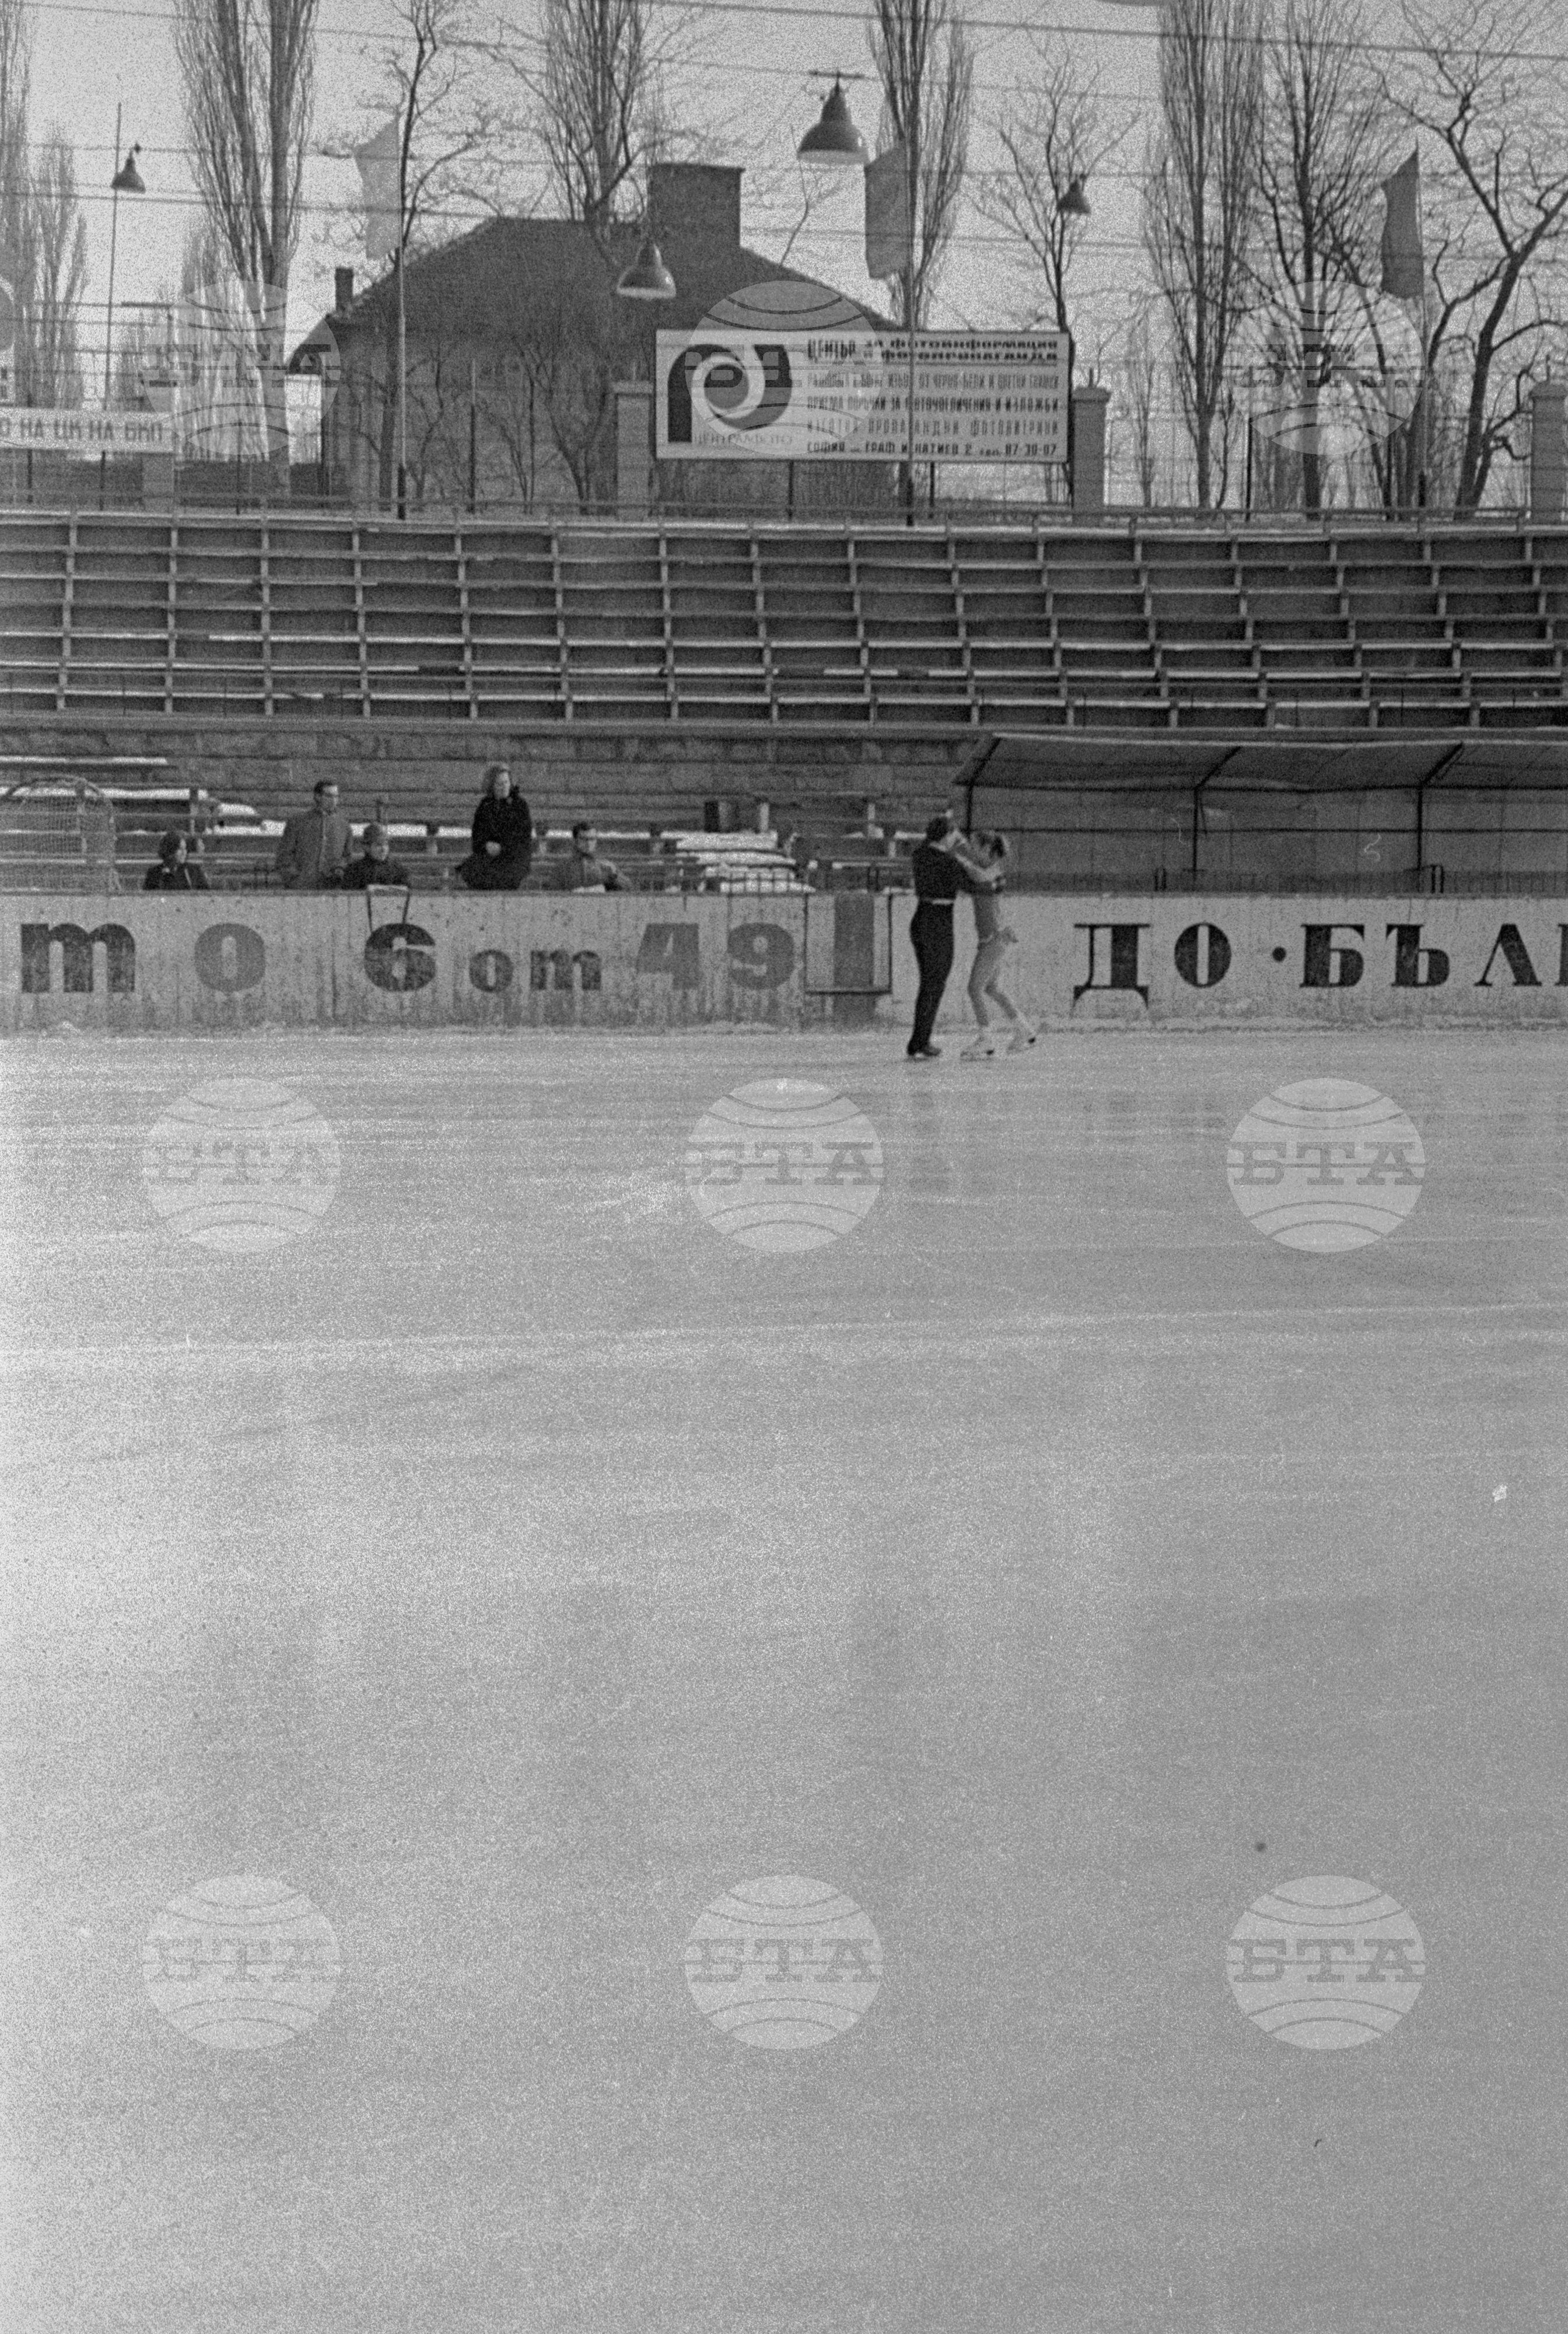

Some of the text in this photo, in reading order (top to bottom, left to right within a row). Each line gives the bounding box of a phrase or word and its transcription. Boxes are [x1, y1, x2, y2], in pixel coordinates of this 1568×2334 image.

[807, 338, 855, 364] ЦЕНТЪР
[881, 349, 1058, 363] фоопропаганда
[869, 418, 960, 436] ПРОПААНДНИ
[901, 442, 959, 456] ИНАТИЕВ
[364, 923, 436, 993] 6
[636, 922, 796, 990] 49
[1299, 923, 1568, 987] БЪЛ
